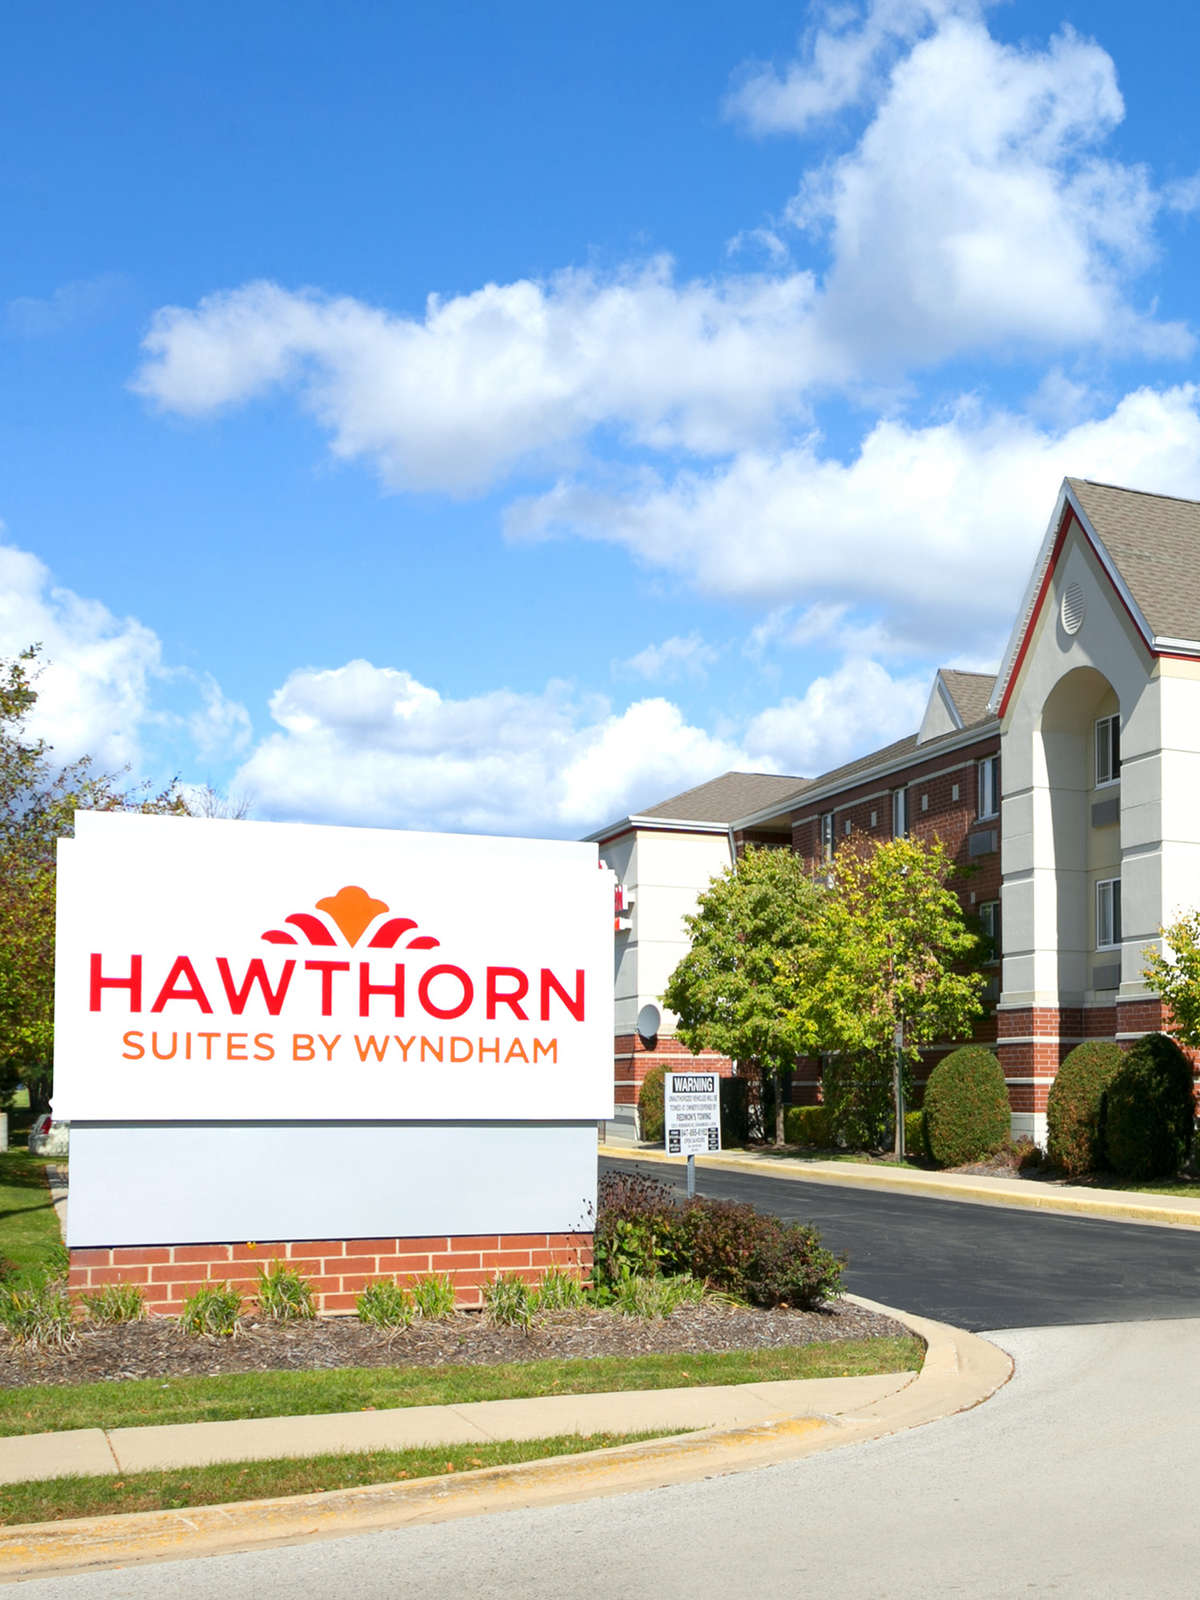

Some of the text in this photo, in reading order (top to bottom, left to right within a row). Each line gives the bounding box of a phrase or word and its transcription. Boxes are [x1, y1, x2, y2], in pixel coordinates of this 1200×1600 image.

[89, 953, 585, 1022] HAWTHORN
[121, 1030, 558, 1065] SUITES BY WYNDHAM
[674, 1077, 713, 1092] WARNING
